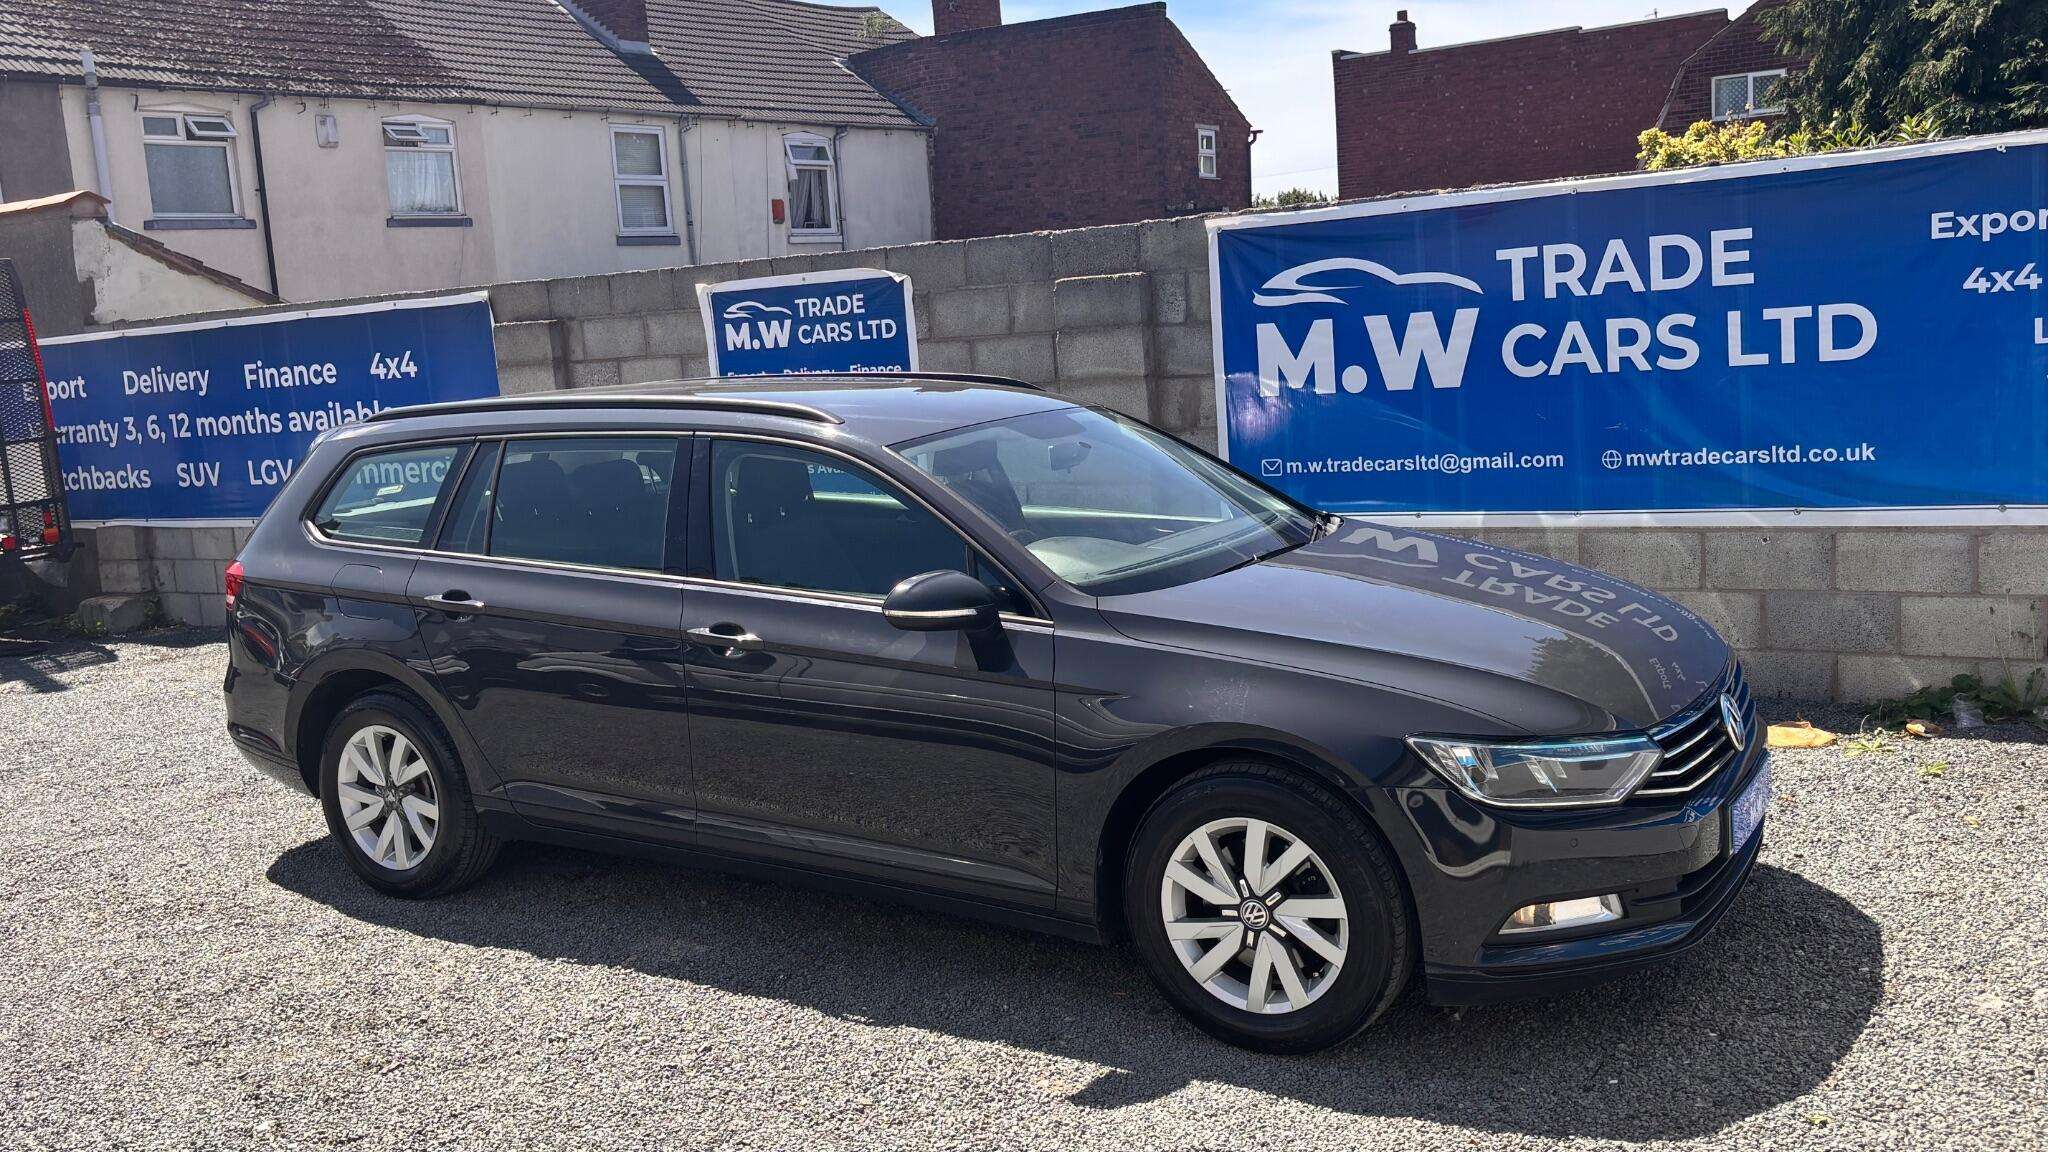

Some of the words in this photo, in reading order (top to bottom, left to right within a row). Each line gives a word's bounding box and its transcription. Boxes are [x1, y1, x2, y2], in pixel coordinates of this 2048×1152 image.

[1931, 208, 2048, 242] Expor
[1496, 227, 1755, 301] TRADE
[1962, 262, 2043, 294] 4x4
[795, 293, 866, 318] TRADE
[724, 319, 792, 351] M.W
[798, 321, 853, 345] CARS
[858, 318, 897, 341] LTD
[1501, 313, 1700, 378] CARS
[1728, 303, 1879, 367] LTD
[1256, 307, 1480, 398] M.W
[123, 365, 209, 397] Delivery
[243, 360, 337, 390] Finance
[370, 350, 418, 380] 4x4
[123, 416, 142, 445] 3,
[147, 413, 166, 443] 6,
[169, 412, 191, 438] 12
[196, 407, 283, 437] months
[288, 400, 392, 432] availabl
[177, 461, 221, 488] SUV
[248, 458, 293, 486] LGV
[1286, 451, 1564, 477] m.w.tradecarsltd@gmail.com
[1626, 441, 1876, 468] mwtradecarsltd.co.uk
